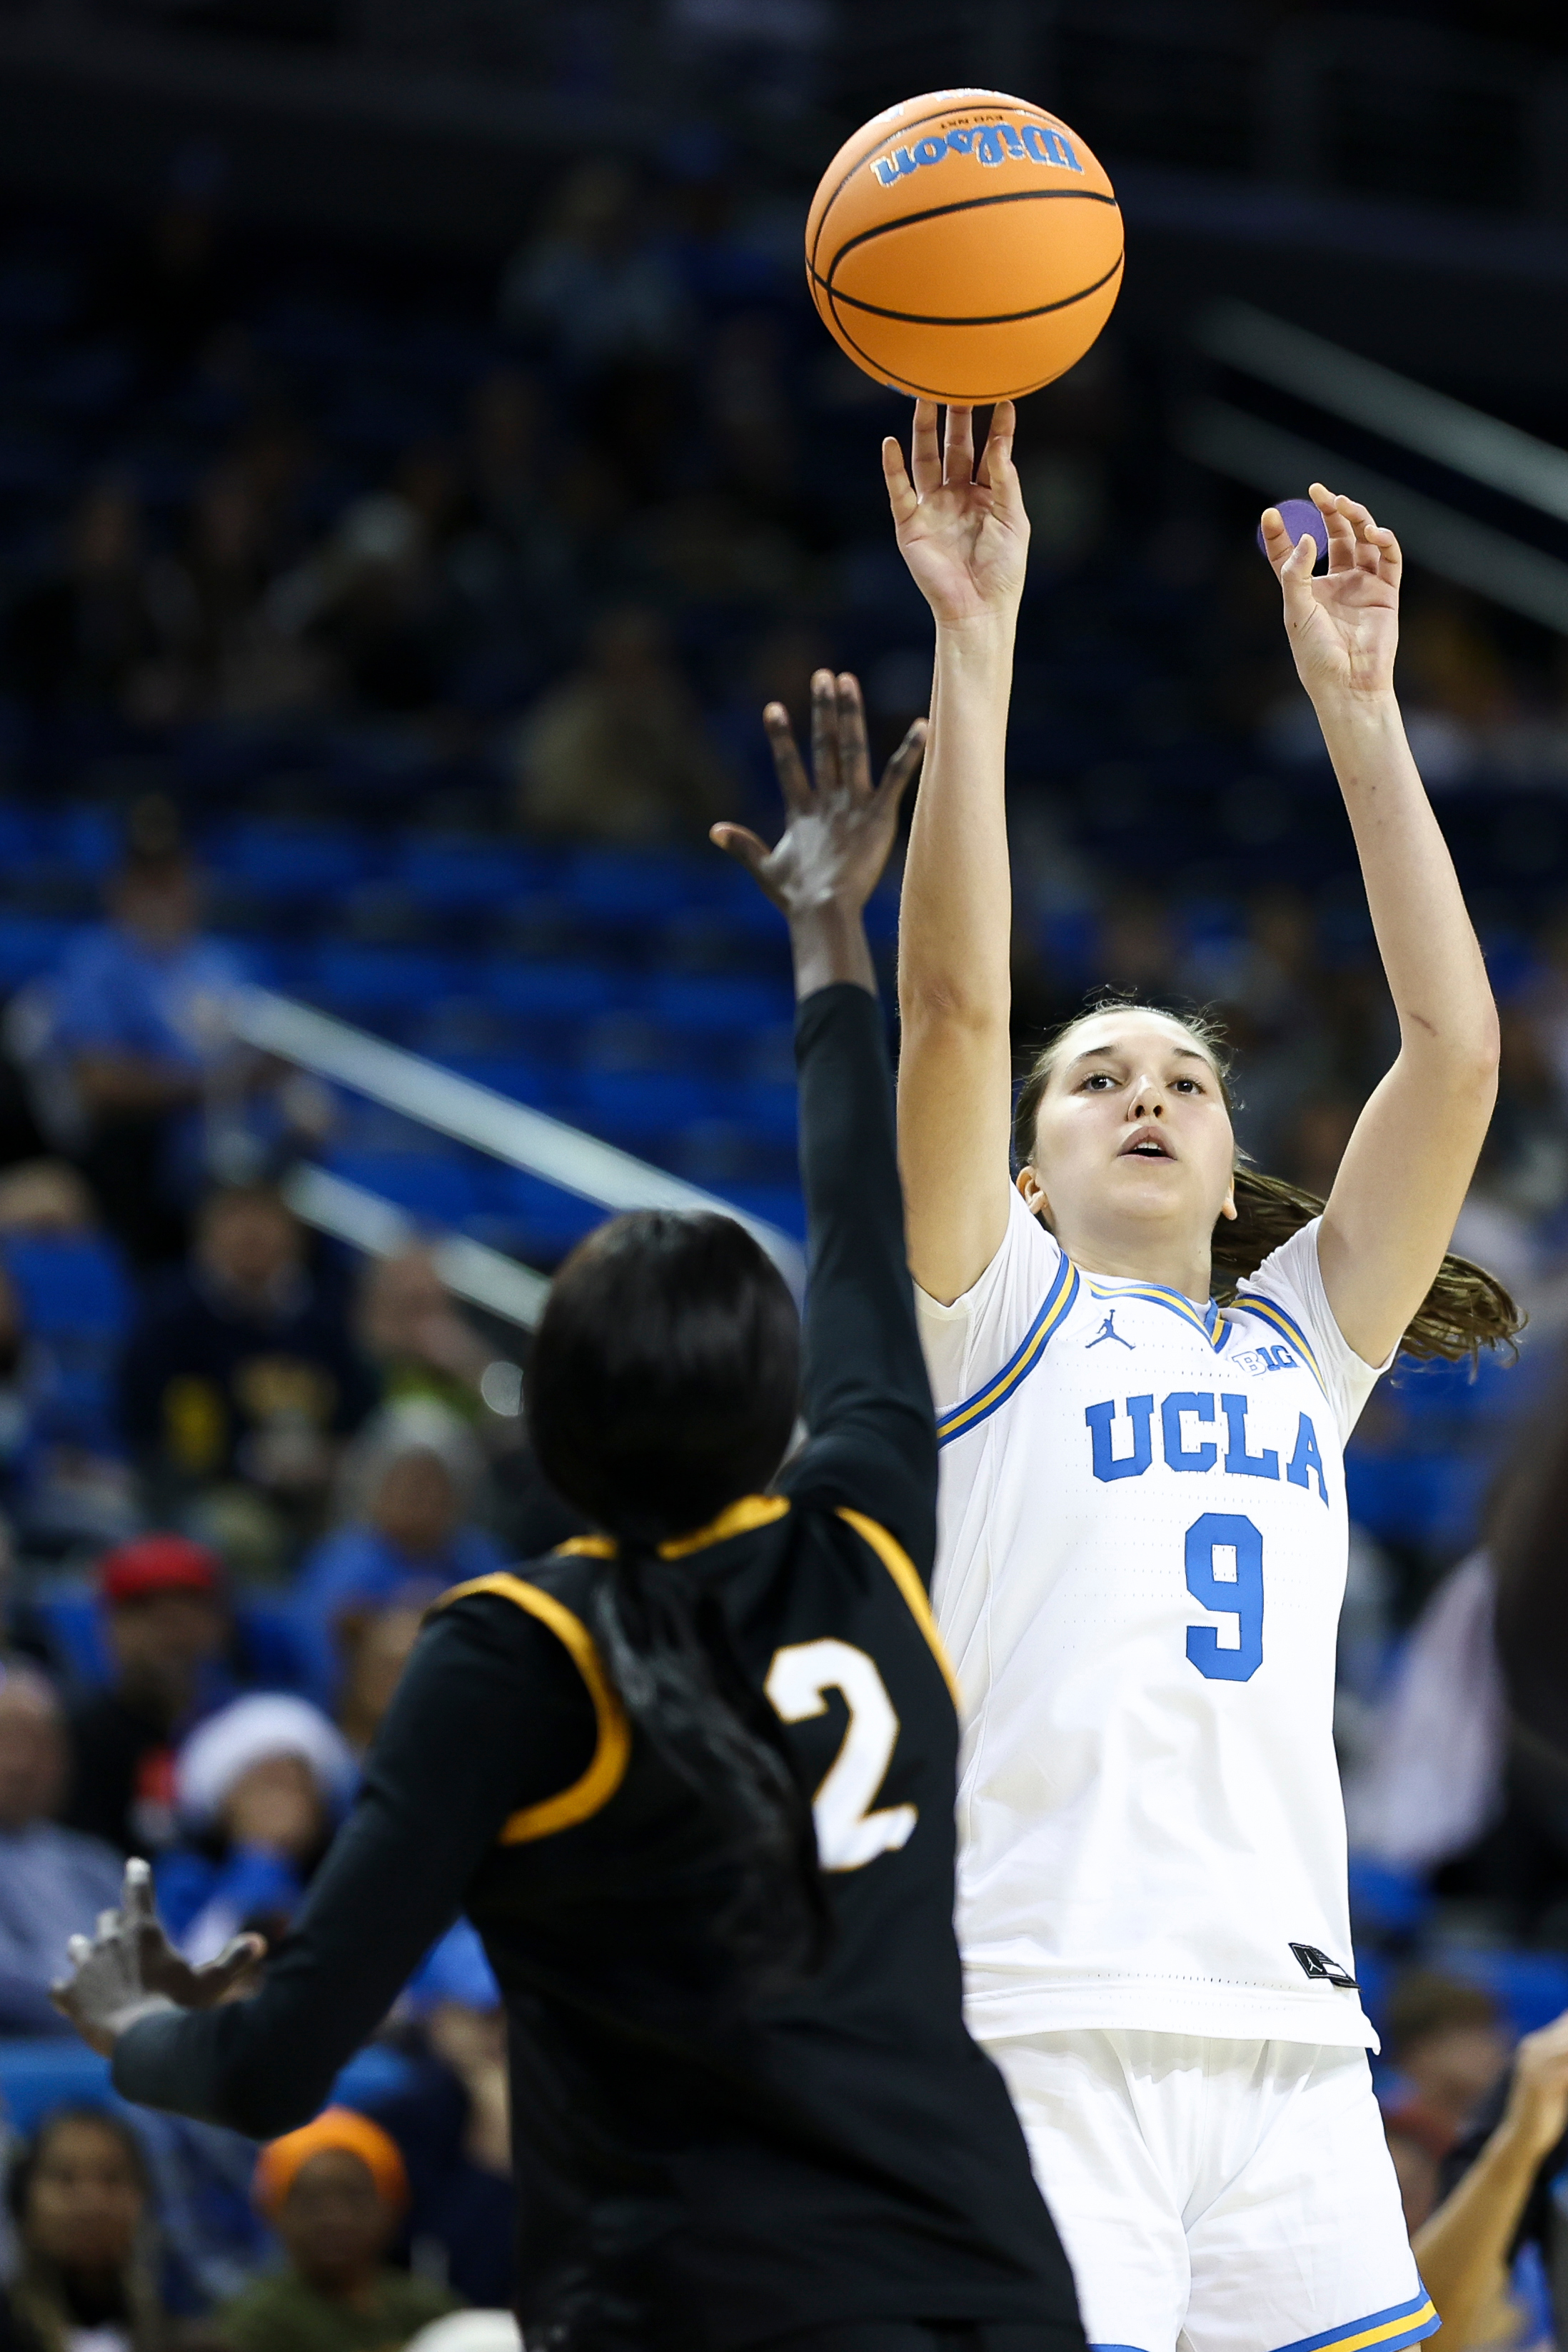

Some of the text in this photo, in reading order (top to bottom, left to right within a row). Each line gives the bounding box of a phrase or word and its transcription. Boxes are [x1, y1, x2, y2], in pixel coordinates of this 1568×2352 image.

[869, 123, 1085, 187] Wilson
[1085, 1392, 1329, 1509] UCLA
[1185, 1512, 1264, 1682] 9
[763, 1635, 920, 1874] 2
